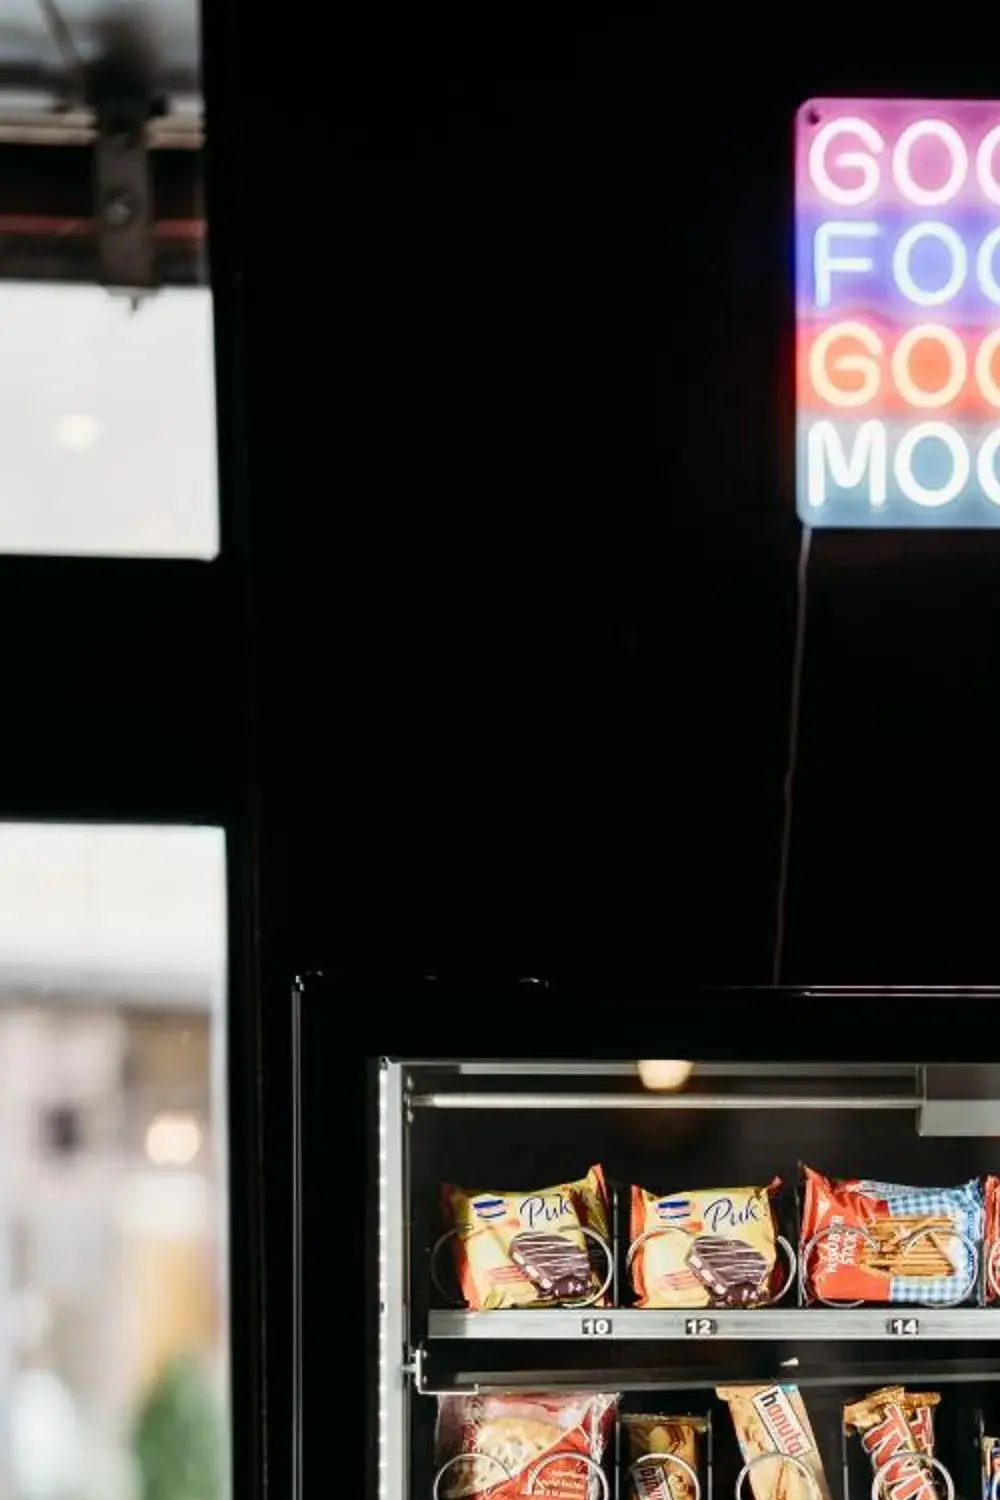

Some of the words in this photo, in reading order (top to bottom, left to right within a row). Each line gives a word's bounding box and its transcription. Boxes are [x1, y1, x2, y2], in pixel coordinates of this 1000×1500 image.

[584, 1320, 609, 1334] 10
[687, 1320, 711, 1334] 12
[893, 1319, 917, 1334] 14
[760, 1386, 802, 1457] hanuta
